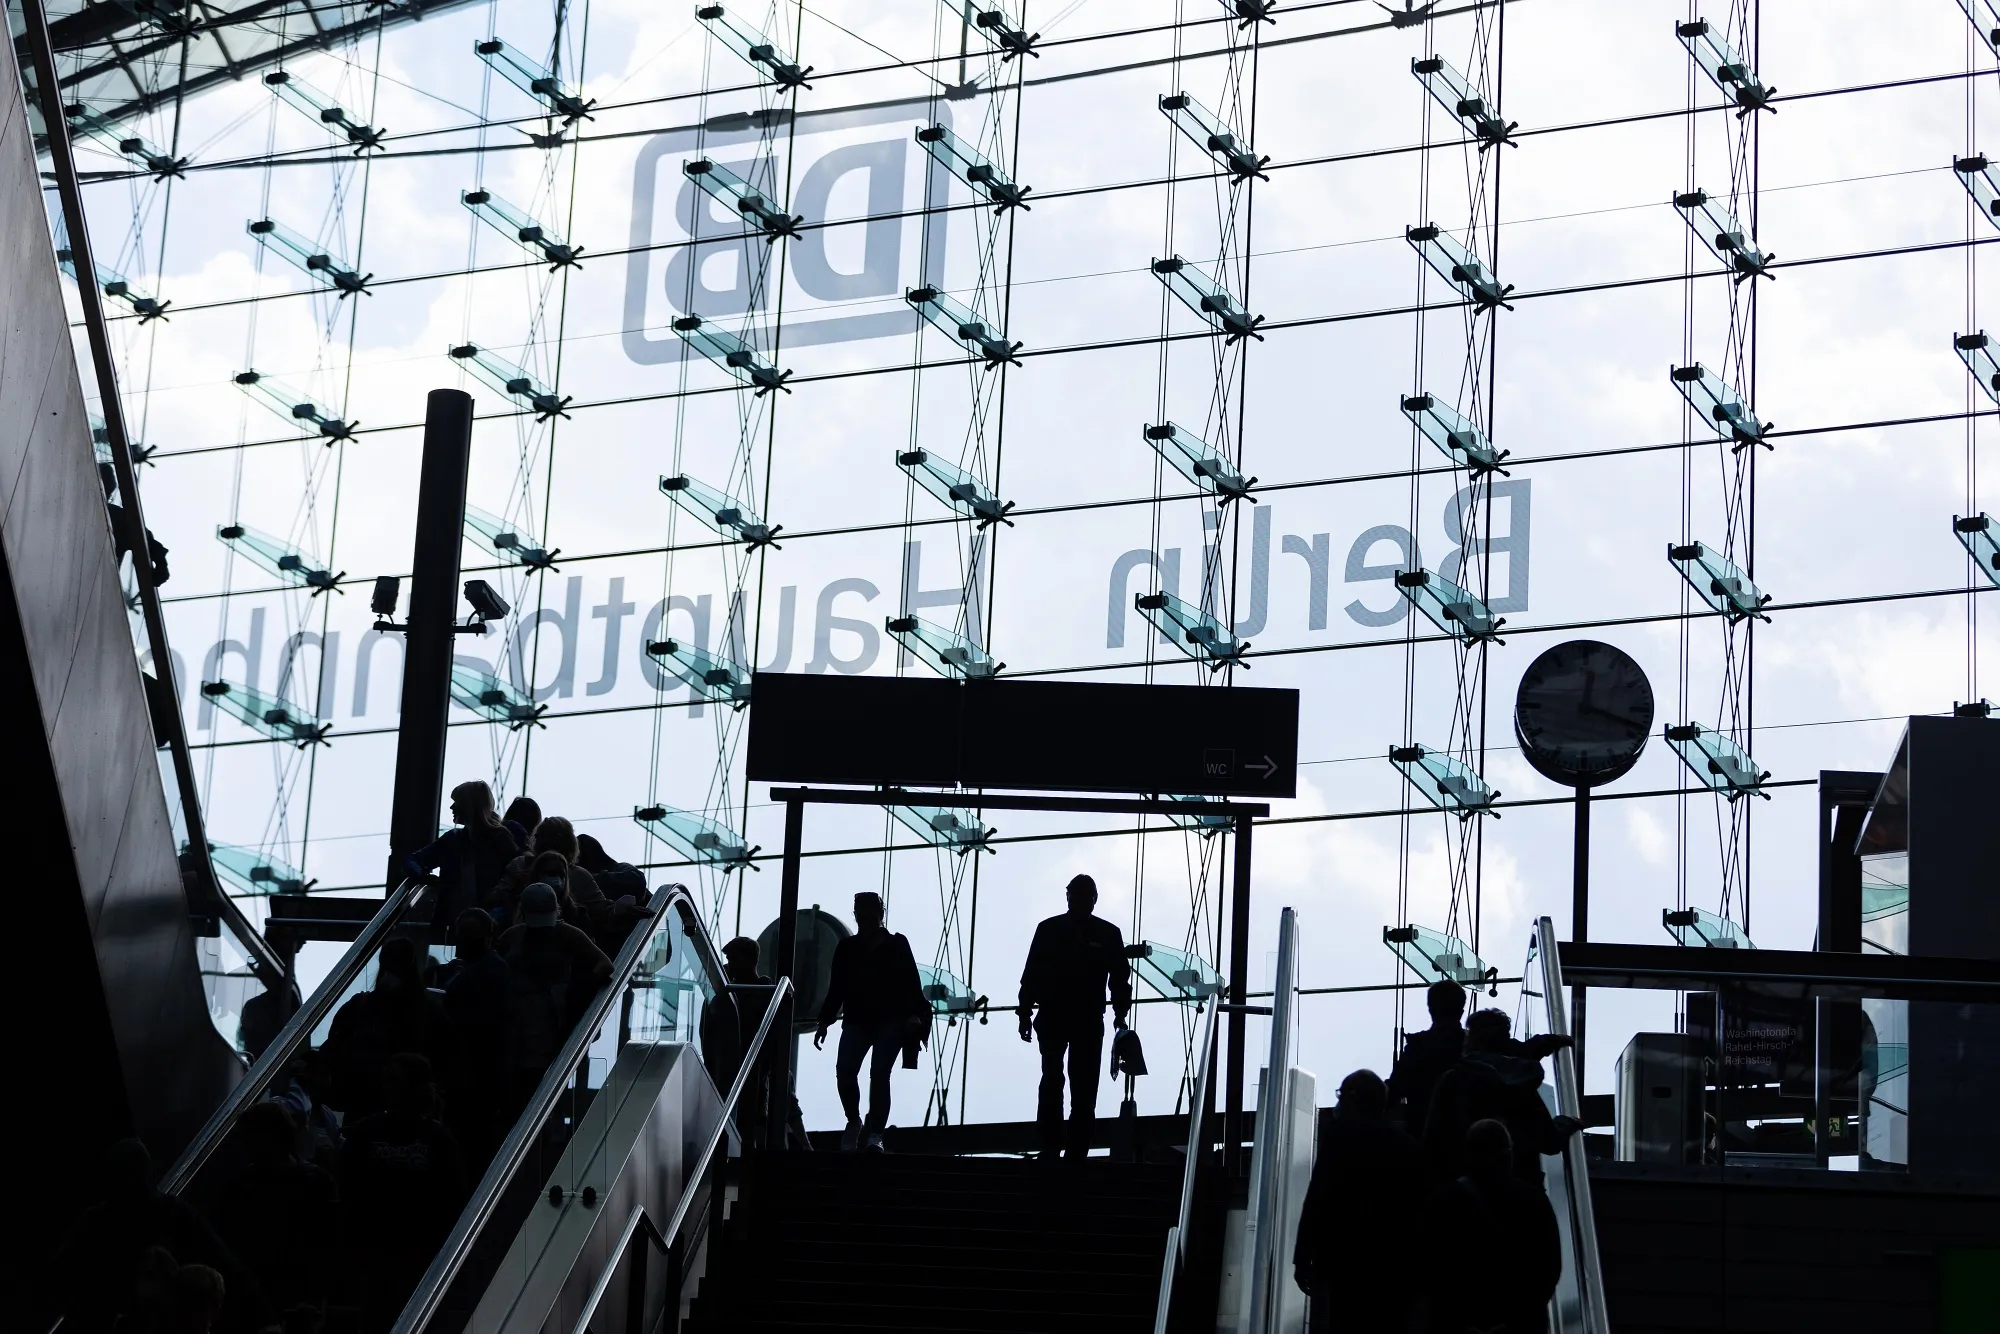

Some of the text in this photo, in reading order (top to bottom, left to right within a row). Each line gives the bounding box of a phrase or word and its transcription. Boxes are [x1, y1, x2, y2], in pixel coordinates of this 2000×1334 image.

[1206, 763, 1227, 775] WC
[1725, 1040, 1795, 1053] Rahel-Hirsch-
[1725, 1055, 1772, 1066] Reichstag
